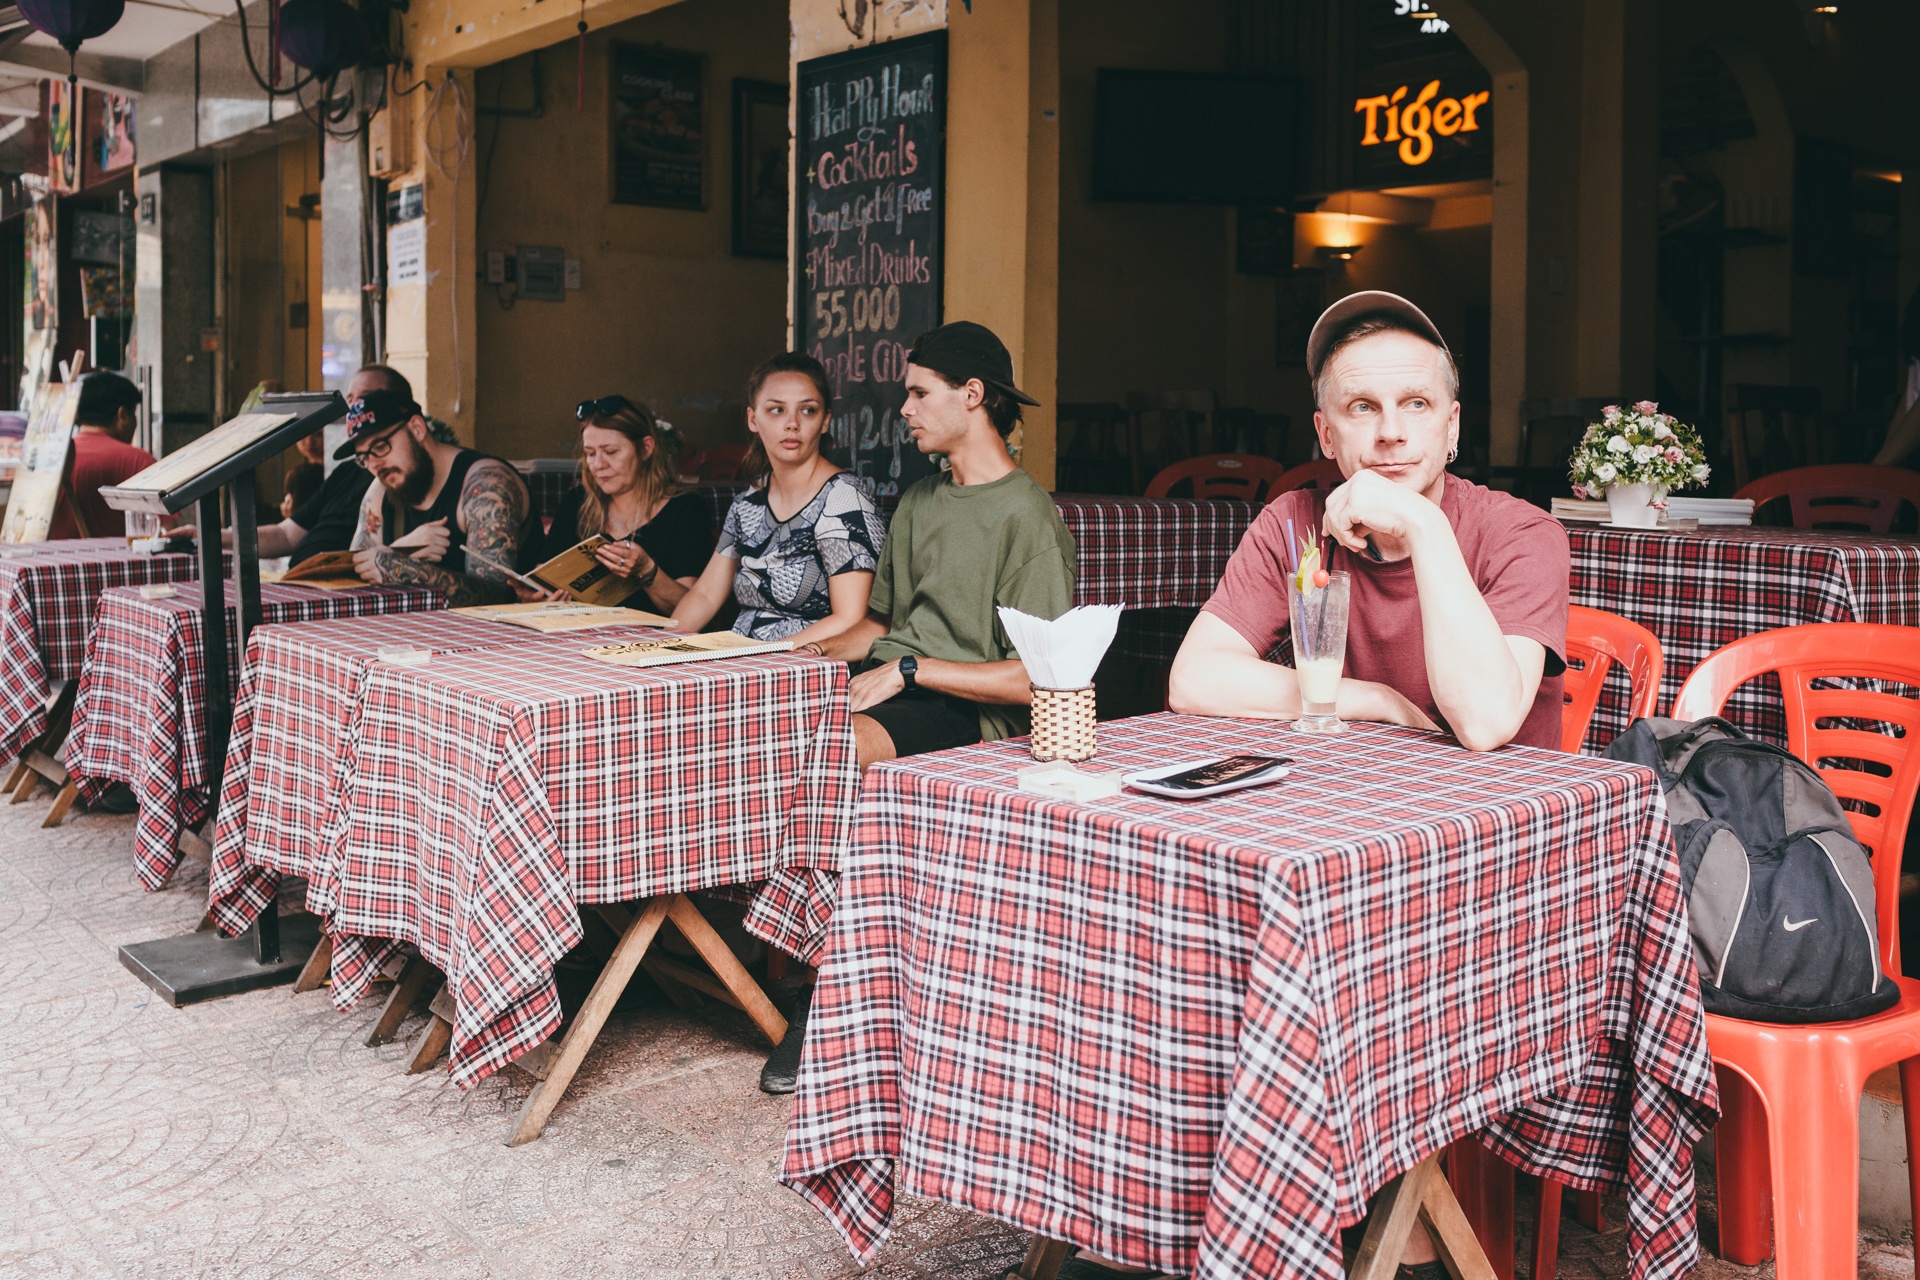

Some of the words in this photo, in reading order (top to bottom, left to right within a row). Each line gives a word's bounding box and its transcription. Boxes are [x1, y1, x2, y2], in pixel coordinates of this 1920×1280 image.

[1354, 79, 1490, 166] Tiger
[840, 201, 853, 231] 2
[882, 181, 895, 222] 1
[815, 283, 901, 339] 55.000
[858, 405, 880, 451] 2
